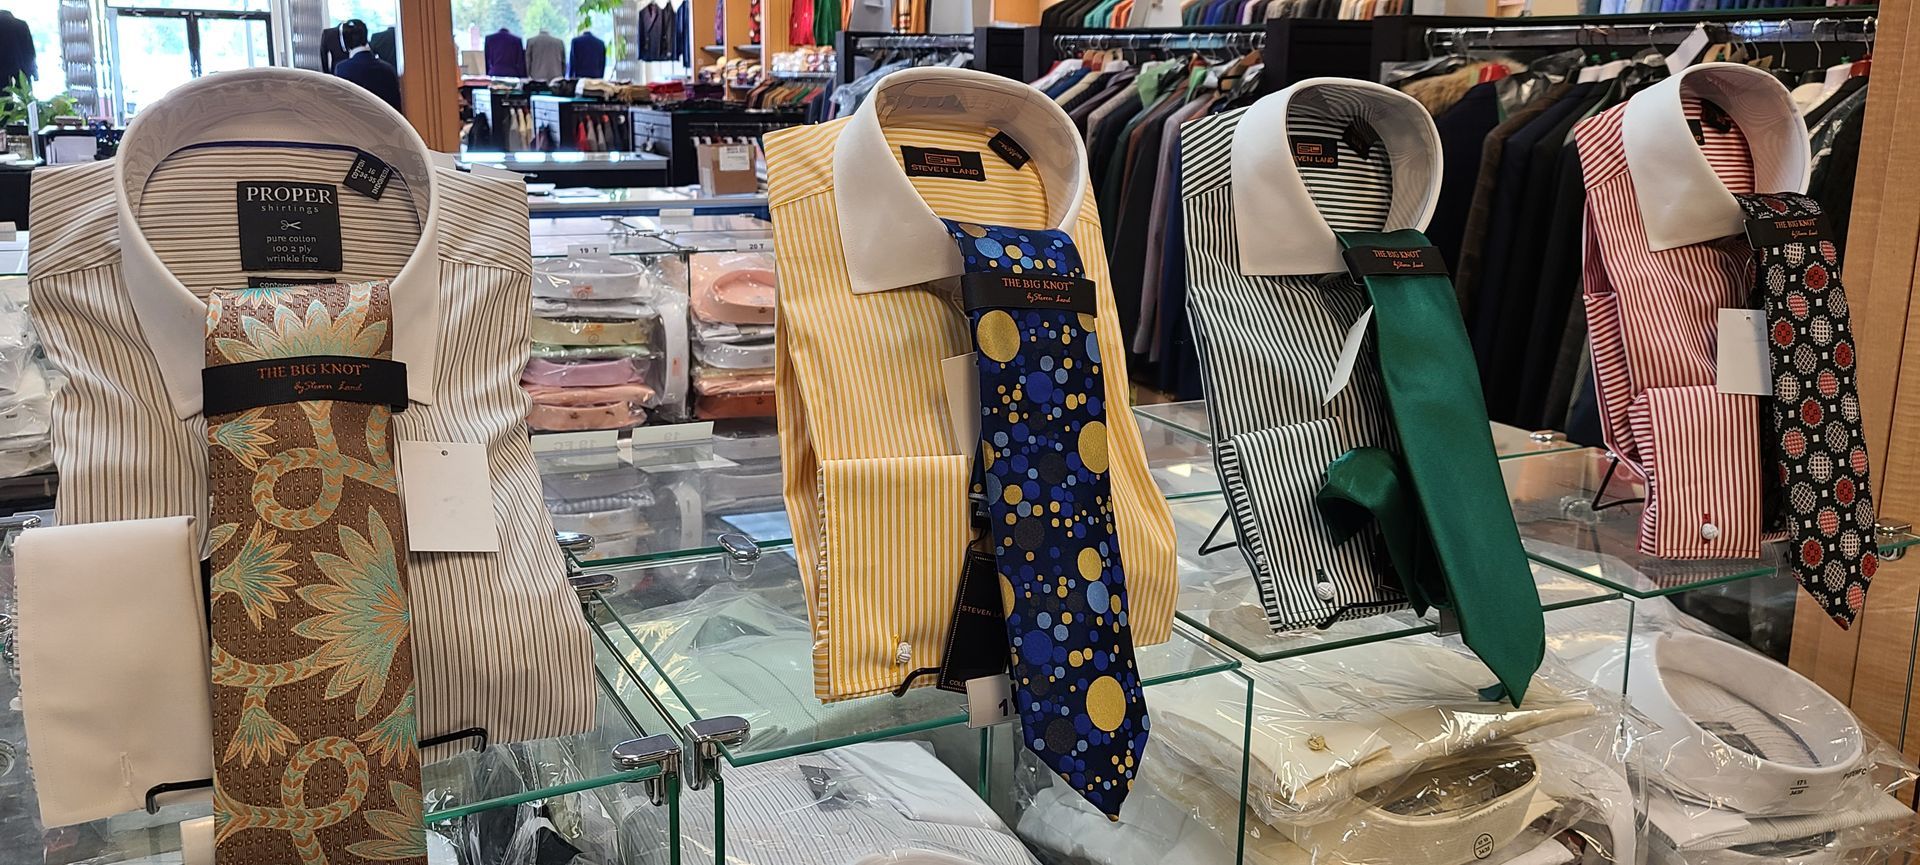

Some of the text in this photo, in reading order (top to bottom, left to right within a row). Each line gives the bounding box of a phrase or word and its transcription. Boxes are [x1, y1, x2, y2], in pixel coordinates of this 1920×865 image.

[911, 164, 979, 176] STEVEN LAND
[246, 186, 333, 204] PROPER
[261, 204, 319, 215] shirtings
[1774, 221, 1787, 229] THE
[1787, 220, 1798, 228] BIG
[299, 245, 311, 254] ply
[1372, 249, 1387, 258] THE
[1387, 250, 1400, 258] BIG
[301, 254, 318, 263] free
[1001, 277, 1022, 288] THE
[1023, 279, 1040, 289] BIG
[257, 366, 287, 379] THE
[290, 363, 316, 377] BIG
[338, 380, 363, 391] Land
[961, 605, 992, 616] STEVEN
[949, 679, 966, 688] COLL
[998, 698, 1009, 717] 1
